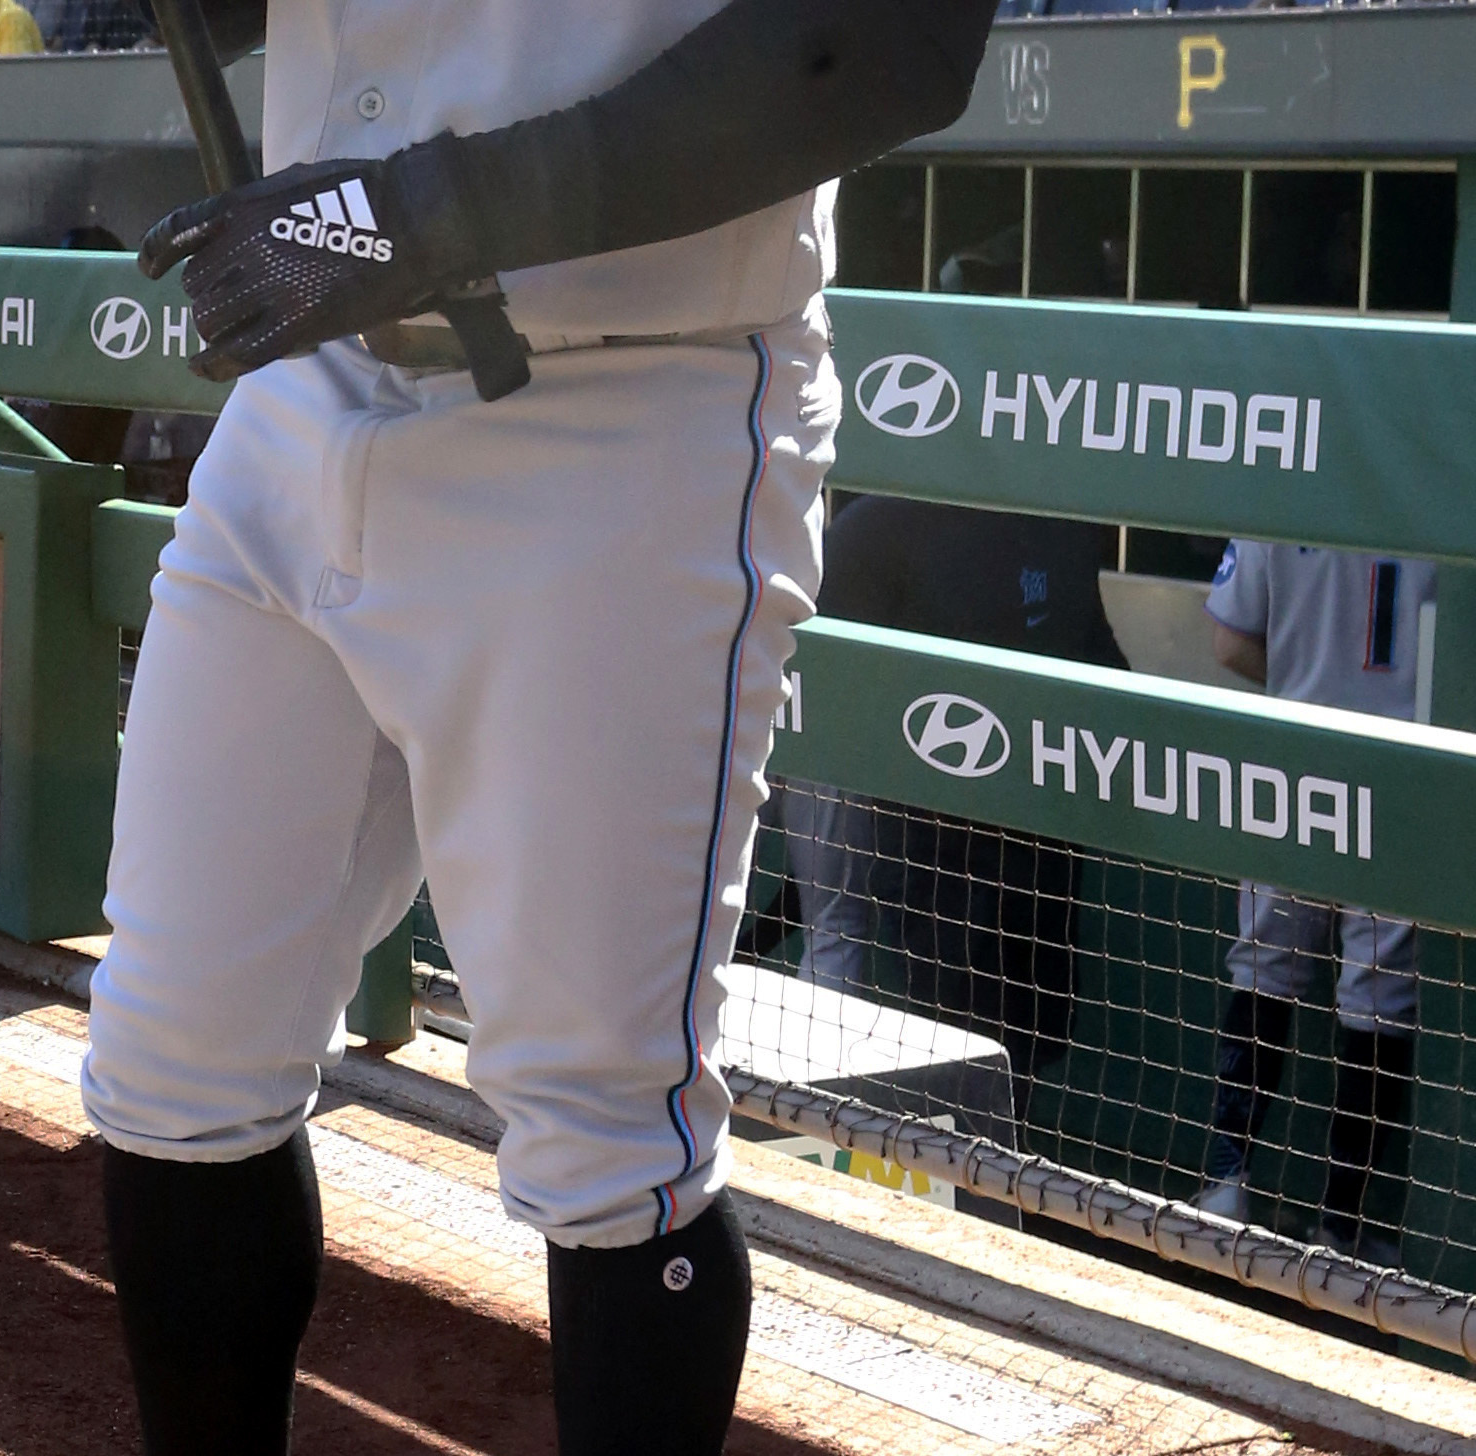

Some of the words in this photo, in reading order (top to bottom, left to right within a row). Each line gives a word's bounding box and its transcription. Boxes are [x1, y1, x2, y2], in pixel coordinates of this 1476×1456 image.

[1176, 33, 1227, 130] P
[269, 215, 394, 264] adidas
[980, 369, 1322, 473] HYUNDAI
[1031, 719, 1374, 860] HYUNDAI
